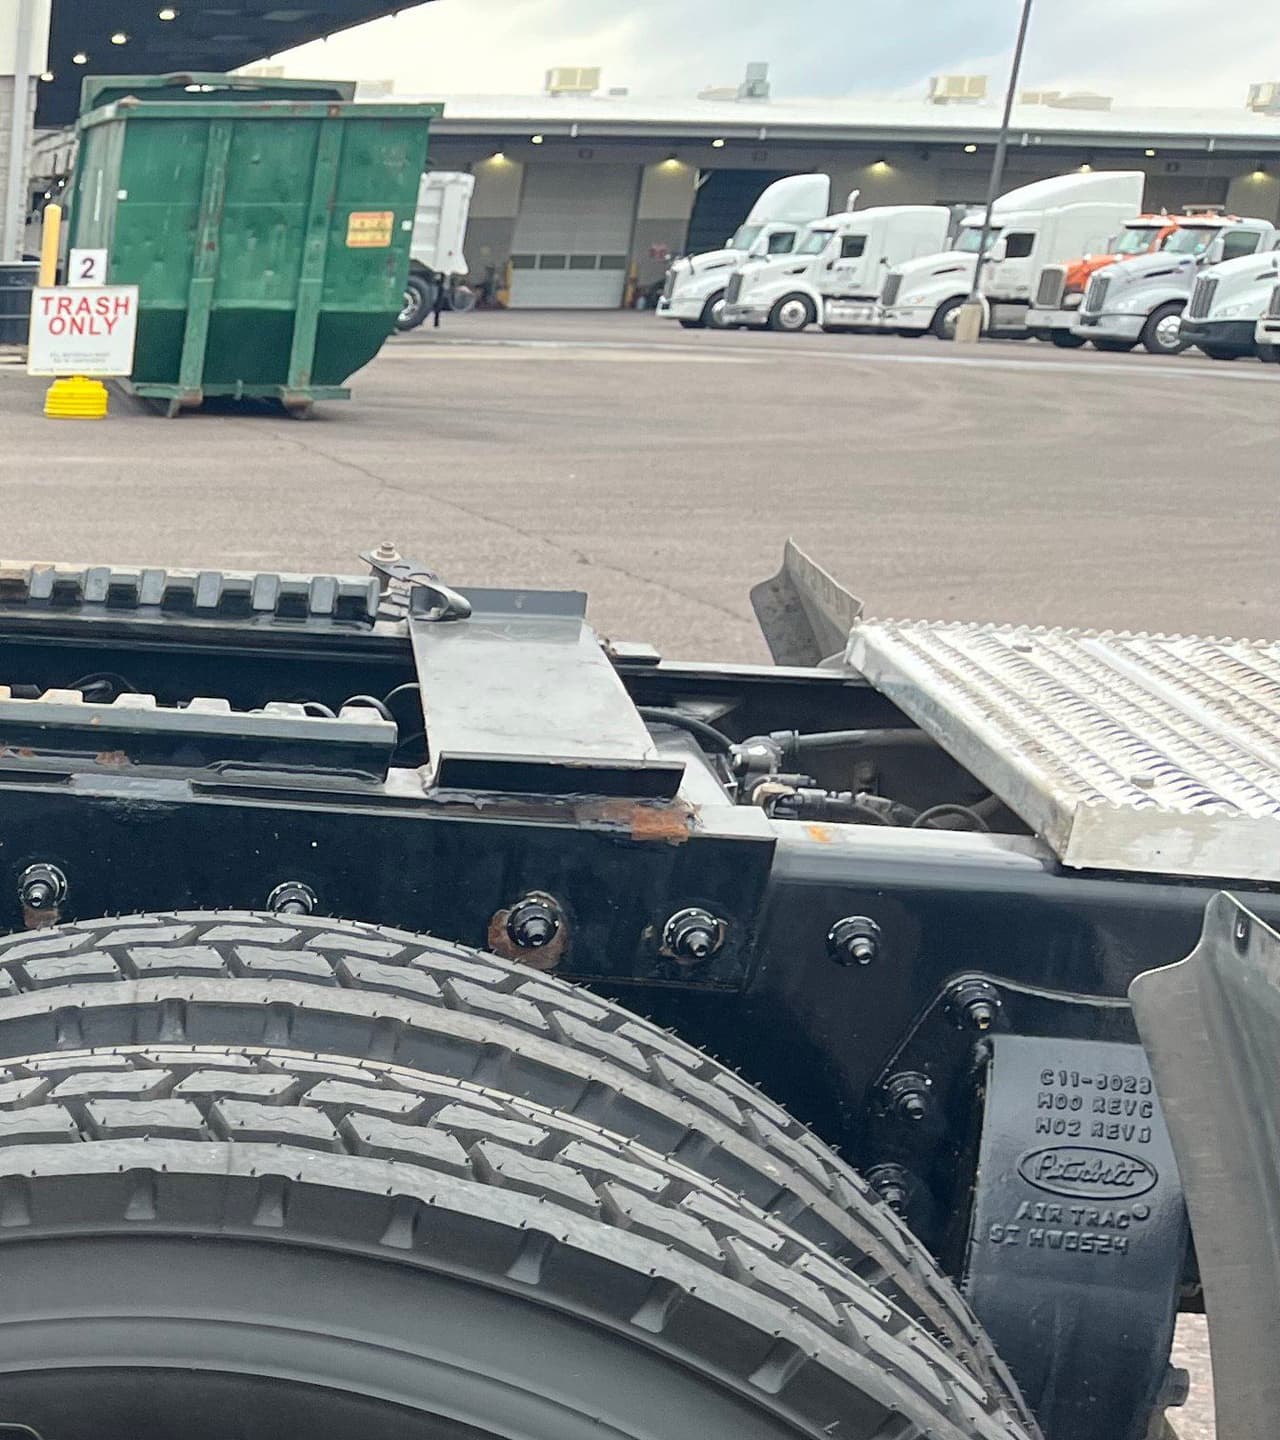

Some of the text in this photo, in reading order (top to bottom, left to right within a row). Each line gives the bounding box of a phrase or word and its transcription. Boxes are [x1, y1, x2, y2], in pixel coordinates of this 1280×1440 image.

[76, 257, 95, 279] 2
[40, 296, 130, 316] TRASH
[48, 316, 119, 335] ONLY
[1015, 1201, 1131, 1229] AIR TRAC
